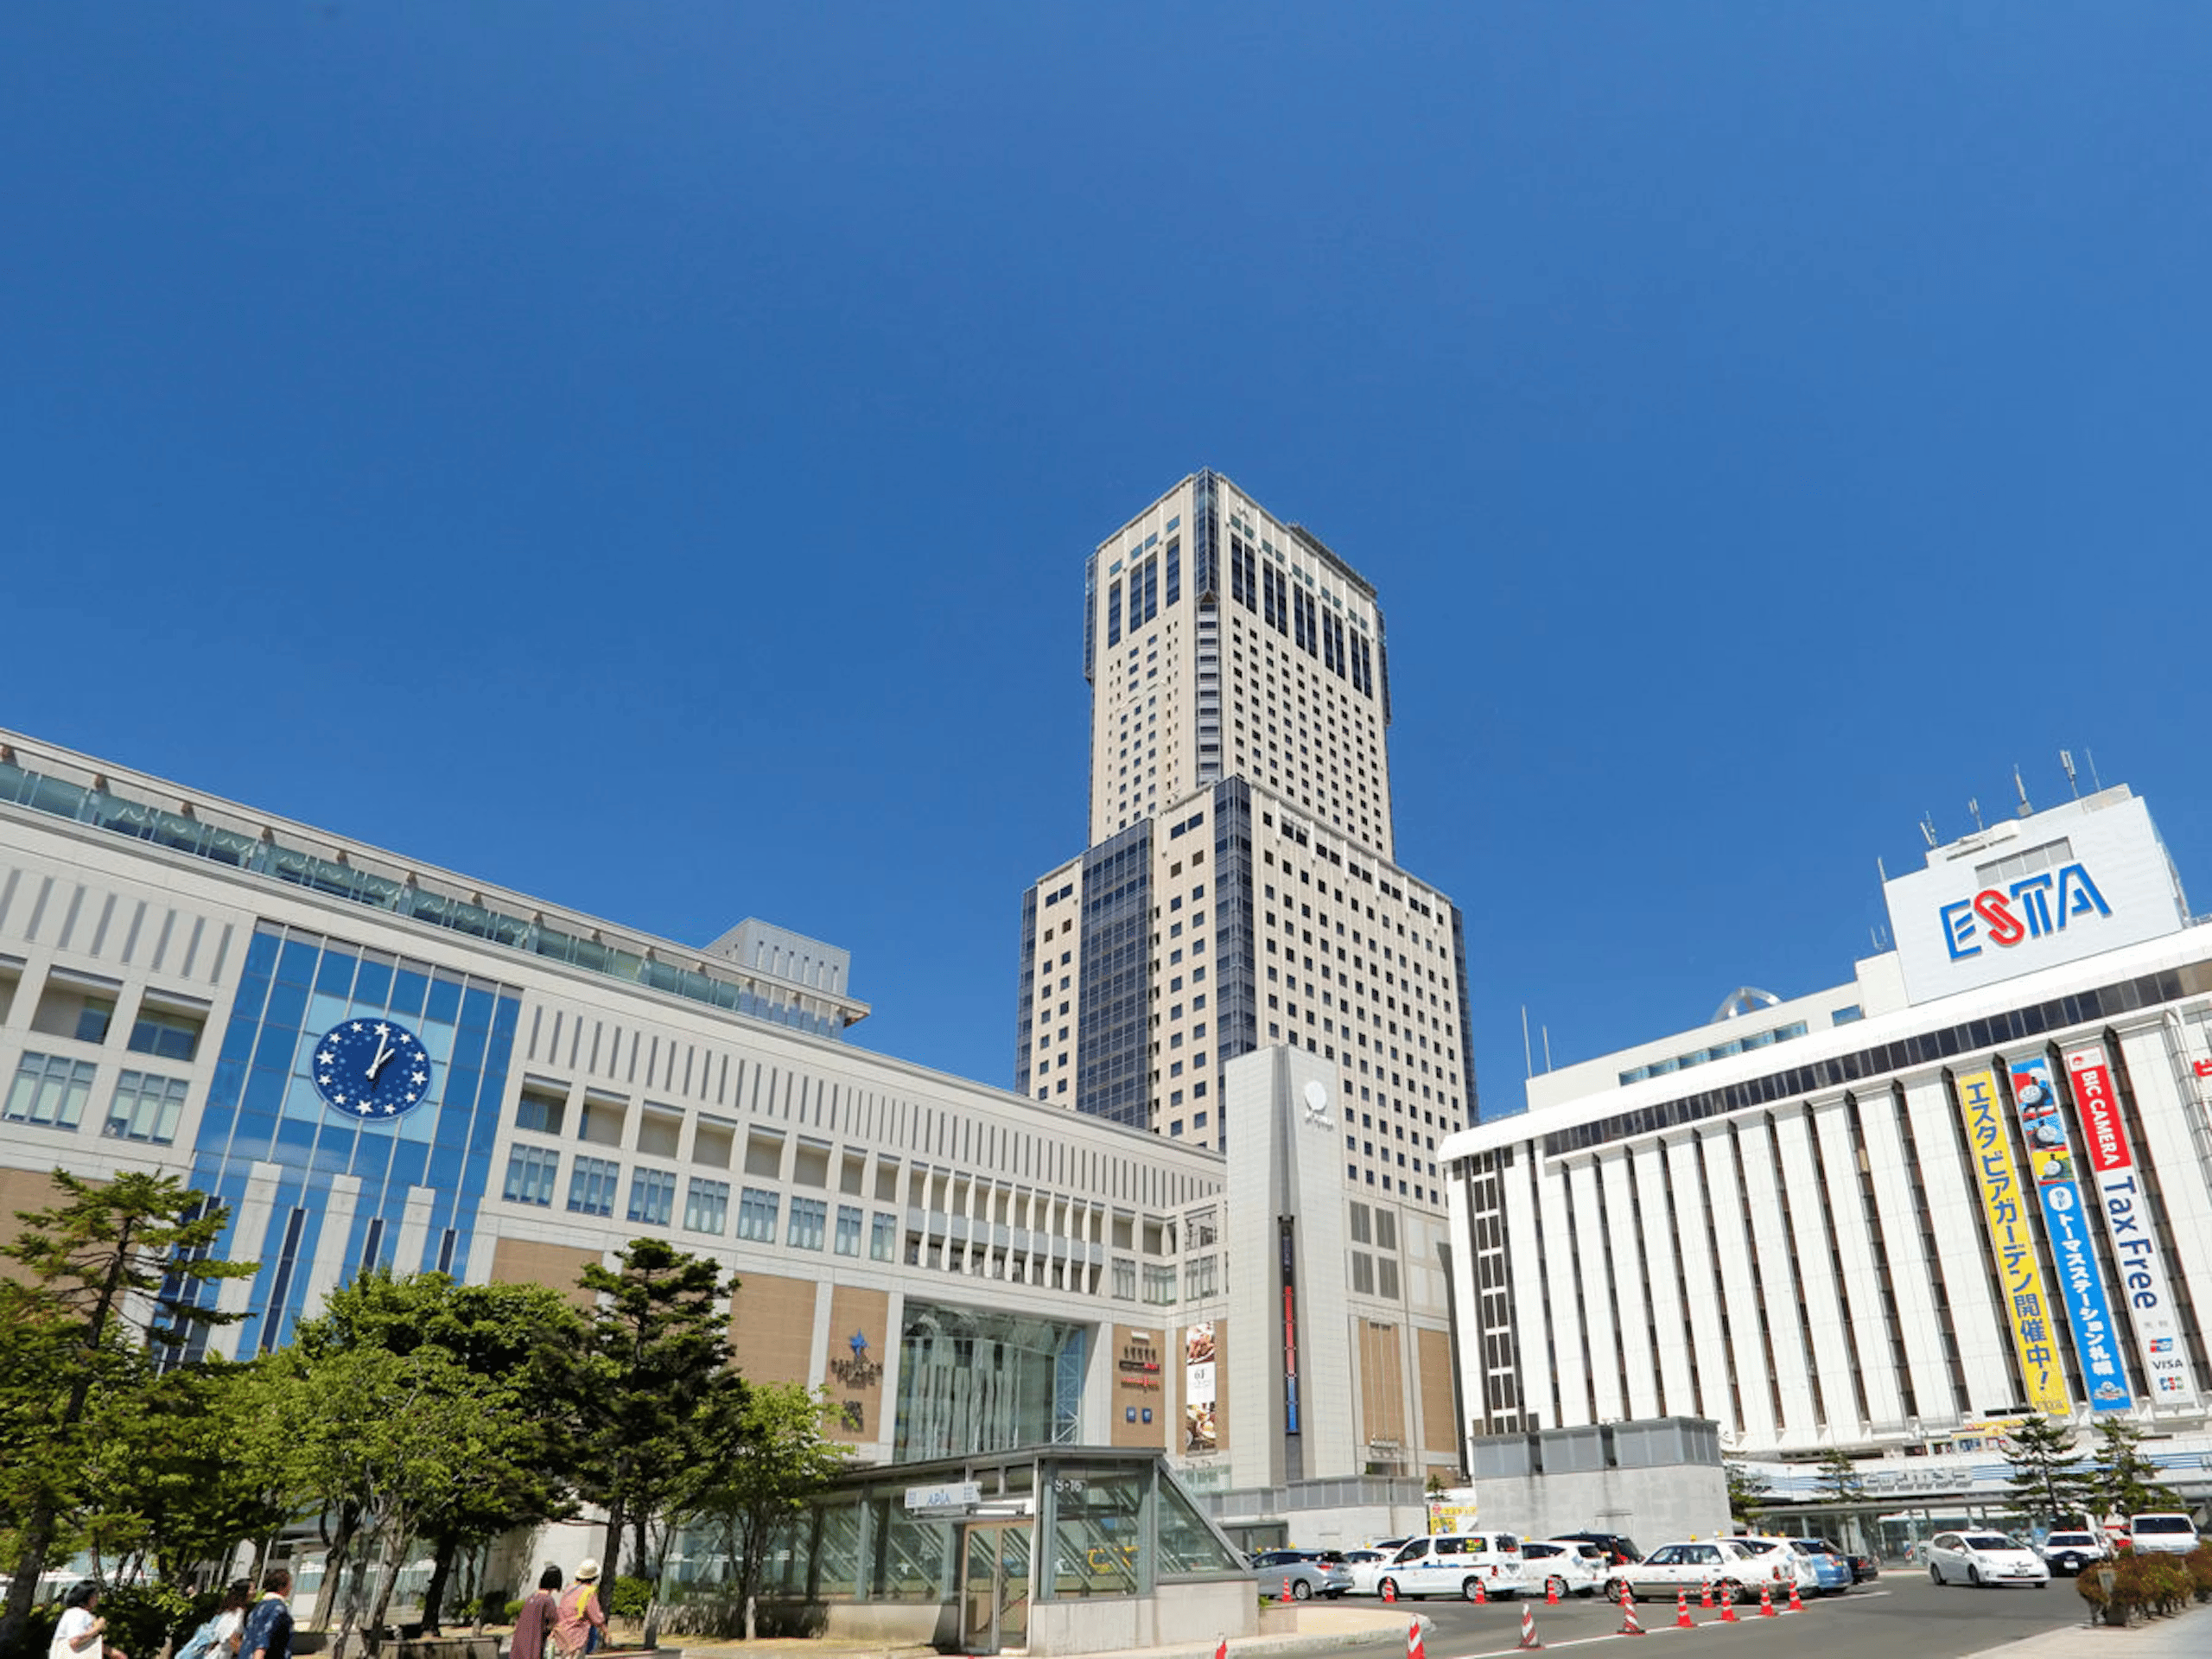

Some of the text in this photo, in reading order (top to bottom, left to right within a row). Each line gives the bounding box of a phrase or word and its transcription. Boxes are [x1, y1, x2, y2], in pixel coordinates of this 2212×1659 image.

[1939, 862, 2112, 962] ESTA
[2081, 1070, 2120, 1166] BIC CAMERA
[2104, 1175, 2139, 1235] Tax
[2119, 1238, 2158, 1309] Free
[2152, 1358, 2183, 1370] VISA
